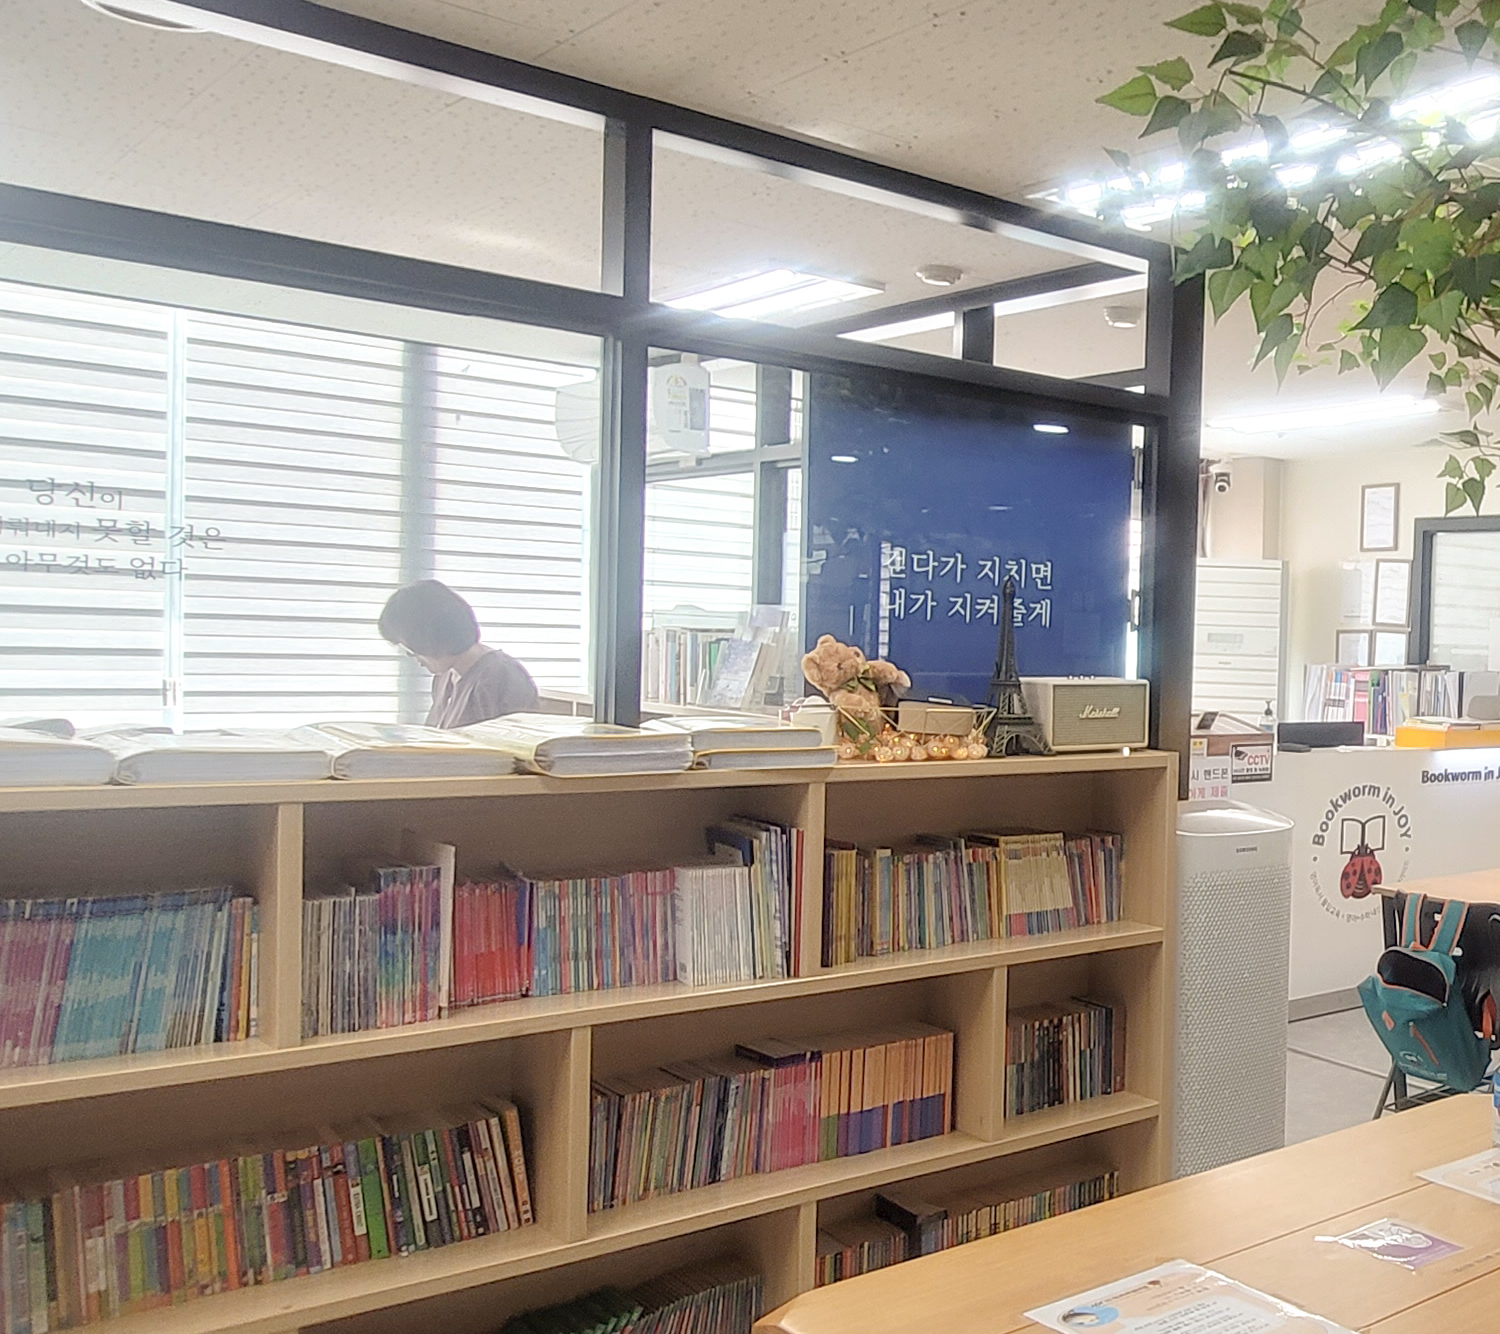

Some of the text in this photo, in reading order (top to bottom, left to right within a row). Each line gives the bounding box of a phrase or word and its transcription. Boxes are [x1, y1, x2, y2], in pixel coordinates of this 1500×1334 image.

[26, 477, 123, 510] 당신이
[0, 517, 226, 550] 뤄내지 못할 것은
[6, 550, 189, 581] 아무것도 없다
[977, 556, 1053, 591] 지치면
[885, 588, 938, 621] 내가
[1247, 754, 1270, 766] CCTV
[1421, 768, 1482, 784] Bookworm
[1484, 766, 1494, 781] in
[1312, 784, 1412, 847] Bookworm in JOY
